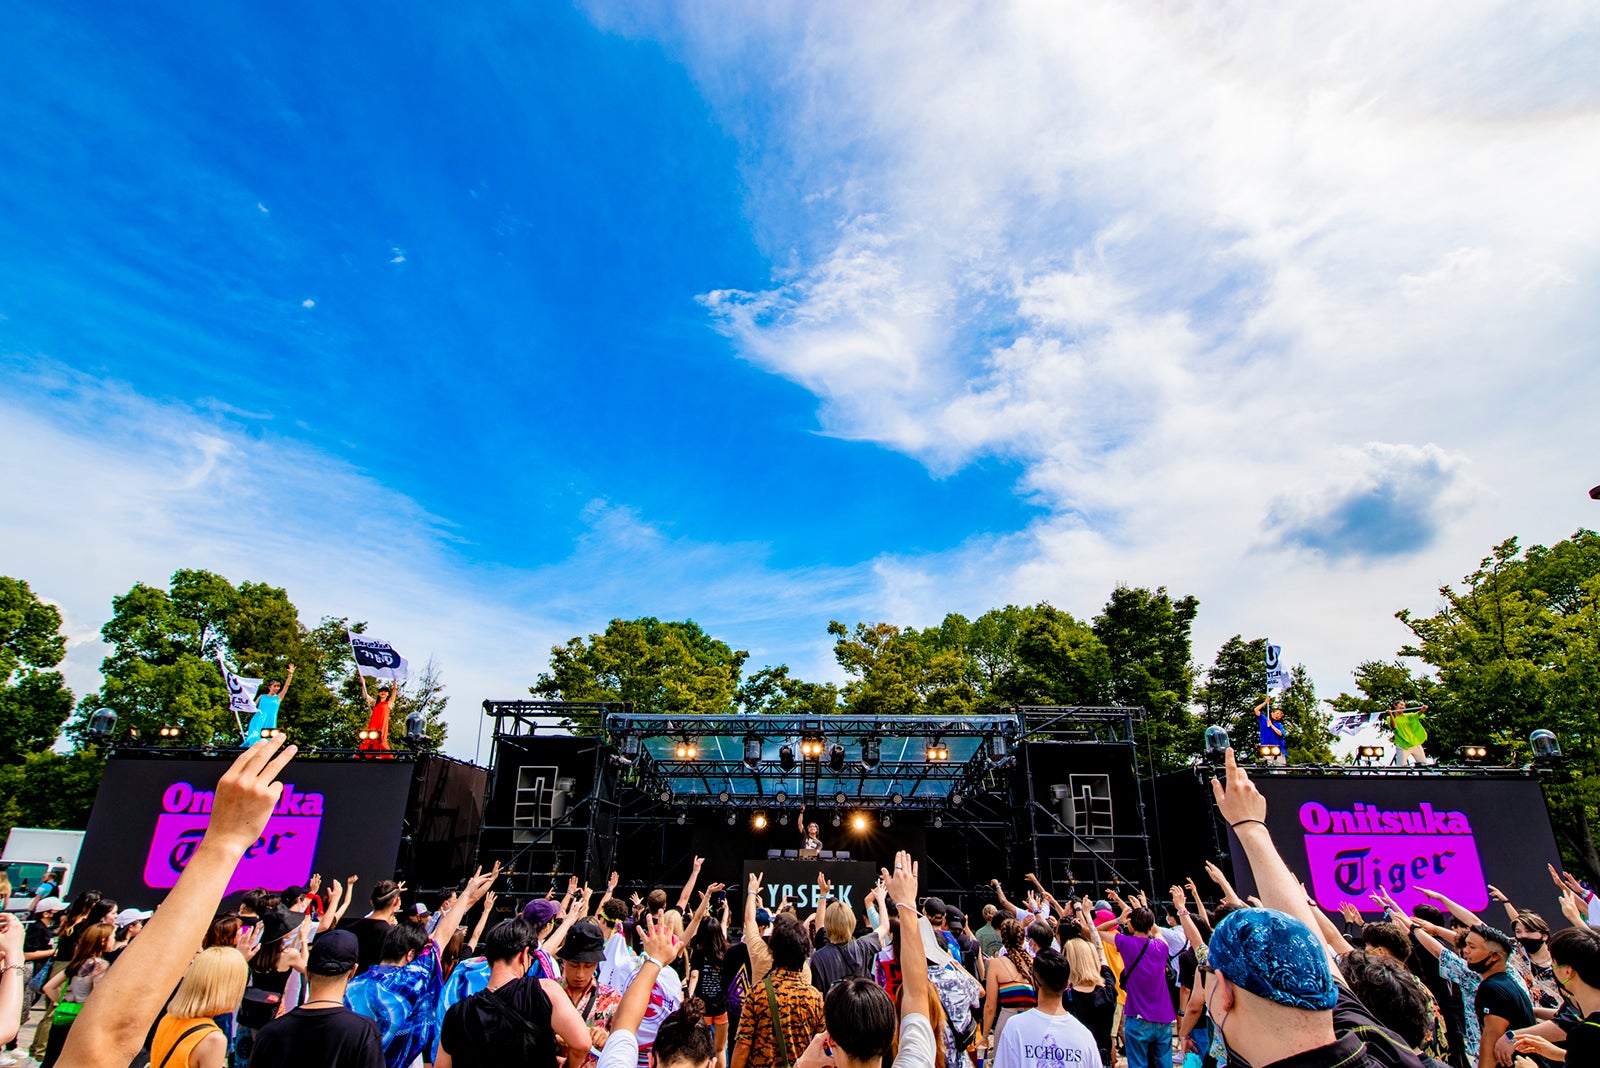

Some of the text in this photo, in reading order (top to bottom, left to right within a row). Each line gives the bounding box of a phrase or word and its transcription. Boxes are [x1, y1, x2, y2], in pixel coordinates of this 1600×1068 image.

[163, 782, 324, 816] Onka
[1299, 801, 1473, 834] Onitsuka
[168, 828, 297, 874] Ter
[1334, 846, 1456, 896] Tiger
[1024, 1044, 1082, 1063] ECHOES
